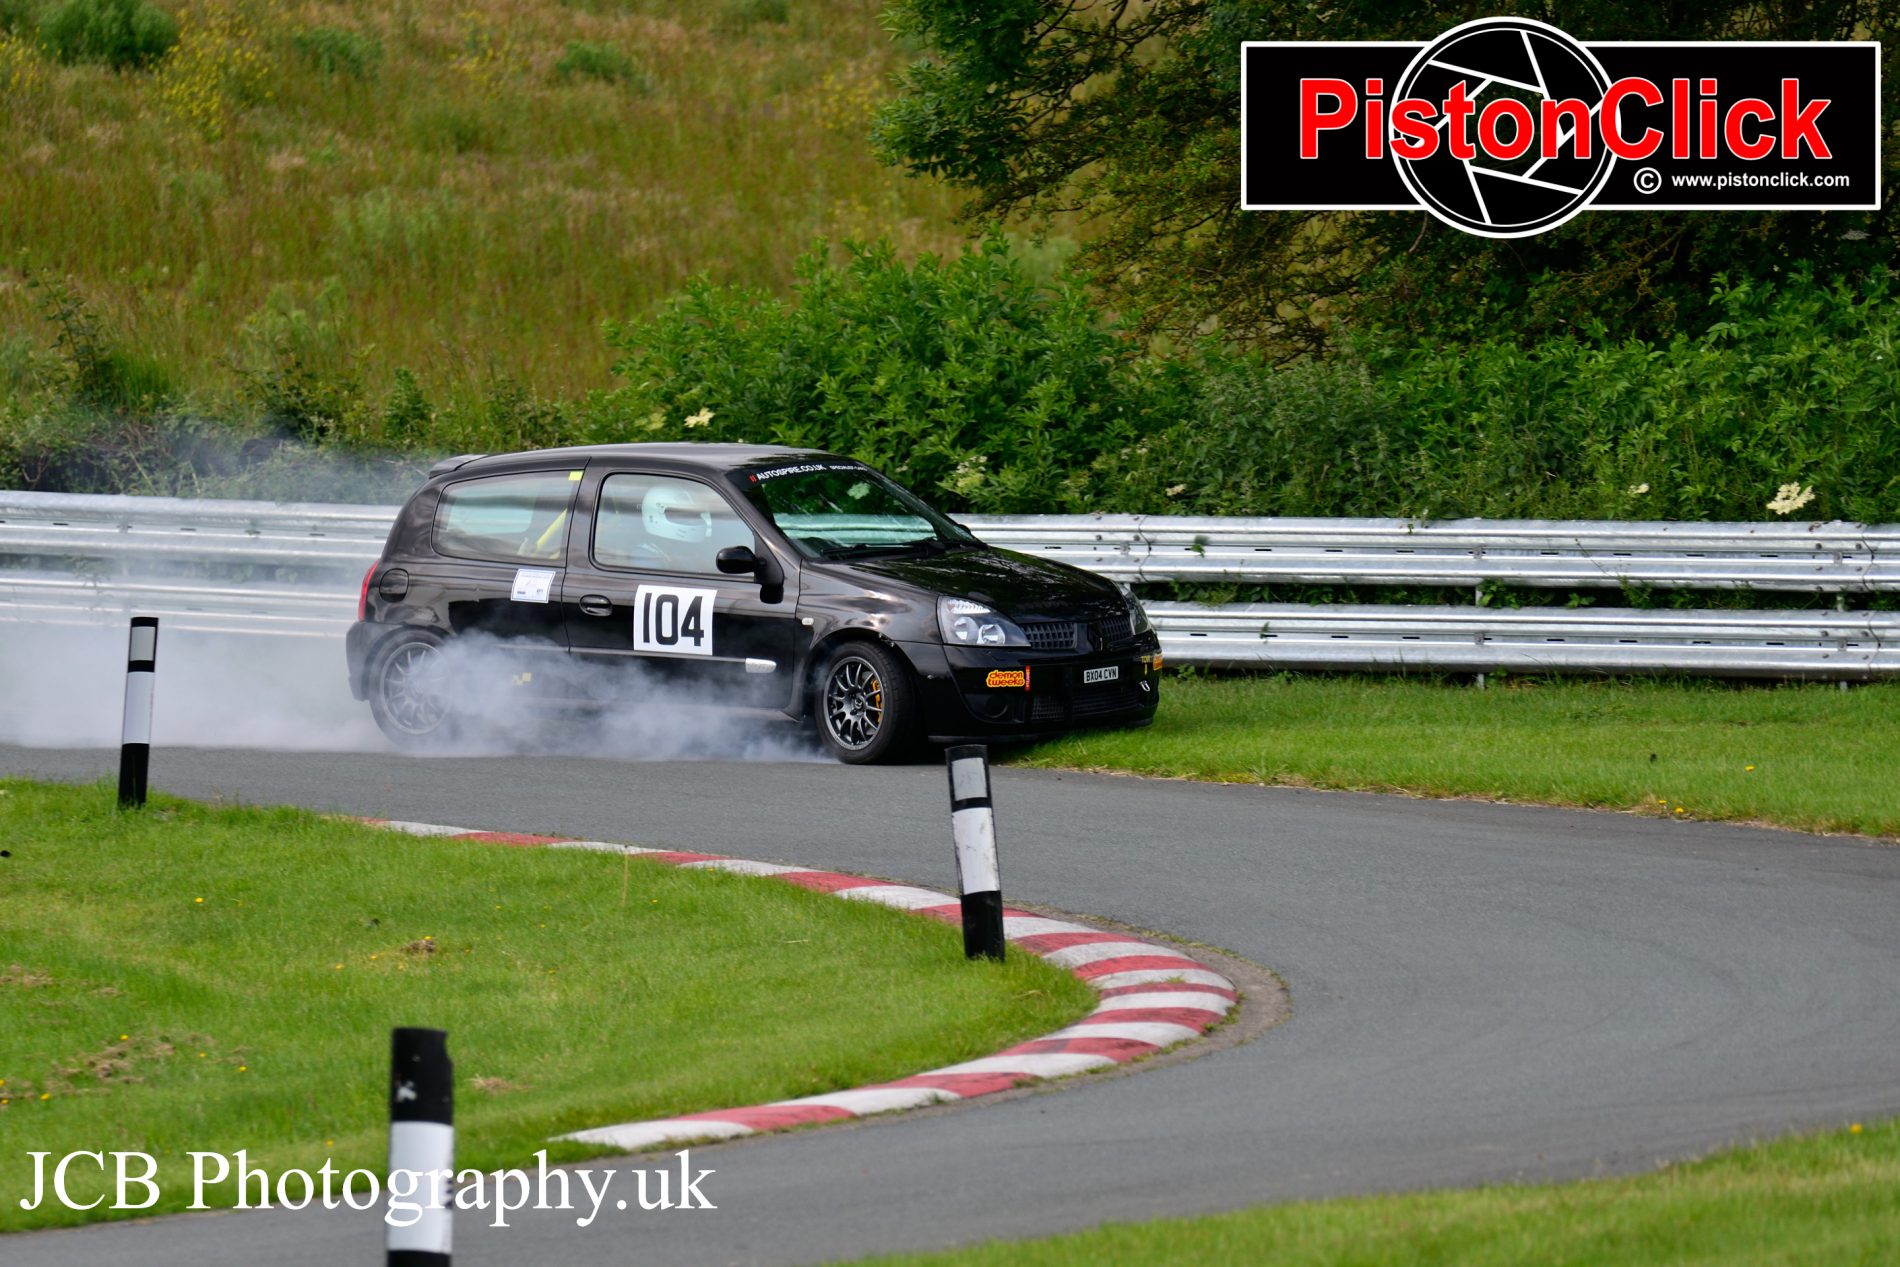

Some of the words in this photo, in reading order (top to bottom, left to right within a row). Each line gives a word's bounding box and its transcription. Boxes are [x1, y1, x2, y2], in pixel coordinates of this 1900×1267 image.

[756, 464, 827, 481] AUTOSPIRE.CO.UK
[642, 592, 705, 647] 104
[987, 678, 1024, 686] tweeks
[989, 670, 1023, 680] demon
[1086, 670, 1103, 682] BX04
[1103, 667, 1117, 680] CVN
